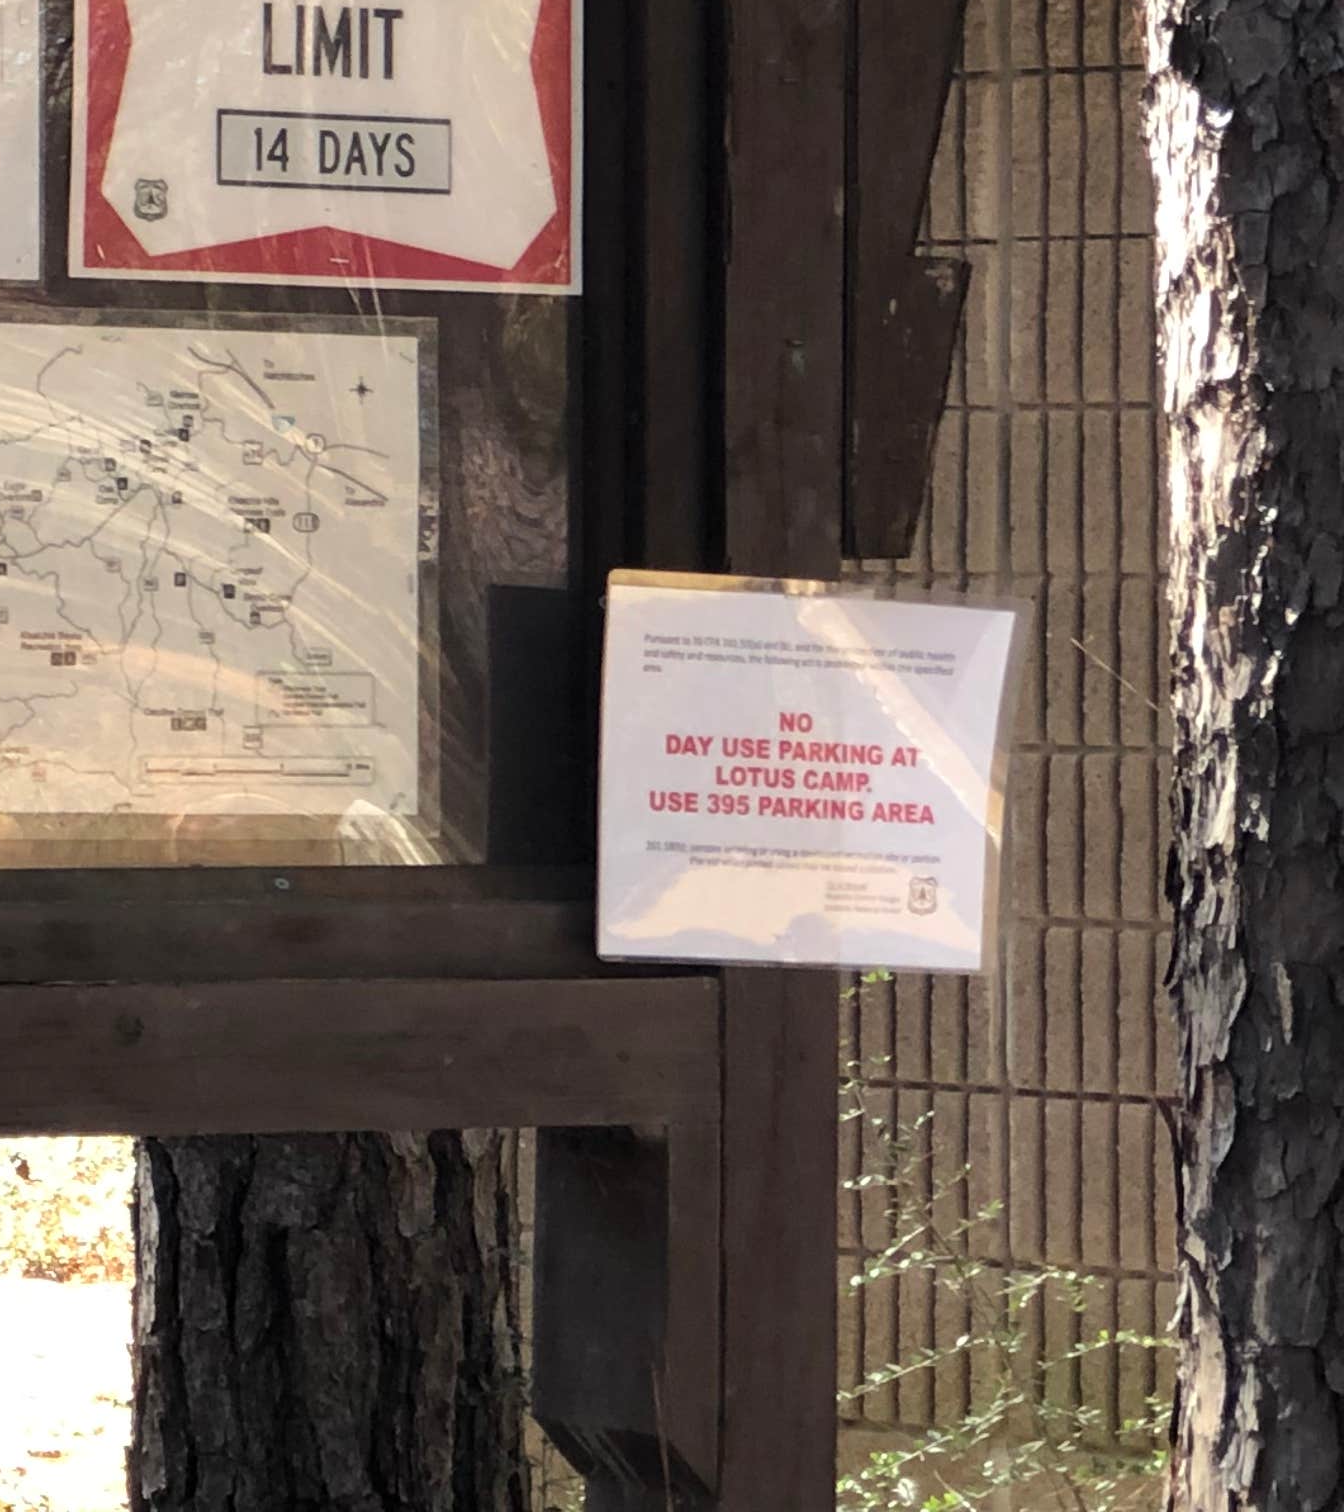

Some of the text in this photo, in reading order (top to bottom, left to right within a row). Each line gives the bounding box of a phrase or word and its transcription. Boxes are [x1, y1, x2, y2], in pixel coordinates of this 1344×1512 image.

[262, 3, 403, 79] LIMIT
[254, 127, 416, 178] 14 DAYS
[779, 712, 813, 732] NO
[665, 734, 922, 767] DAY USE PARKING AT
[716, 766, 872, 793] LOTUS CAMP.
[649, 791, 935, 824] USE 395 PARKING AREA
